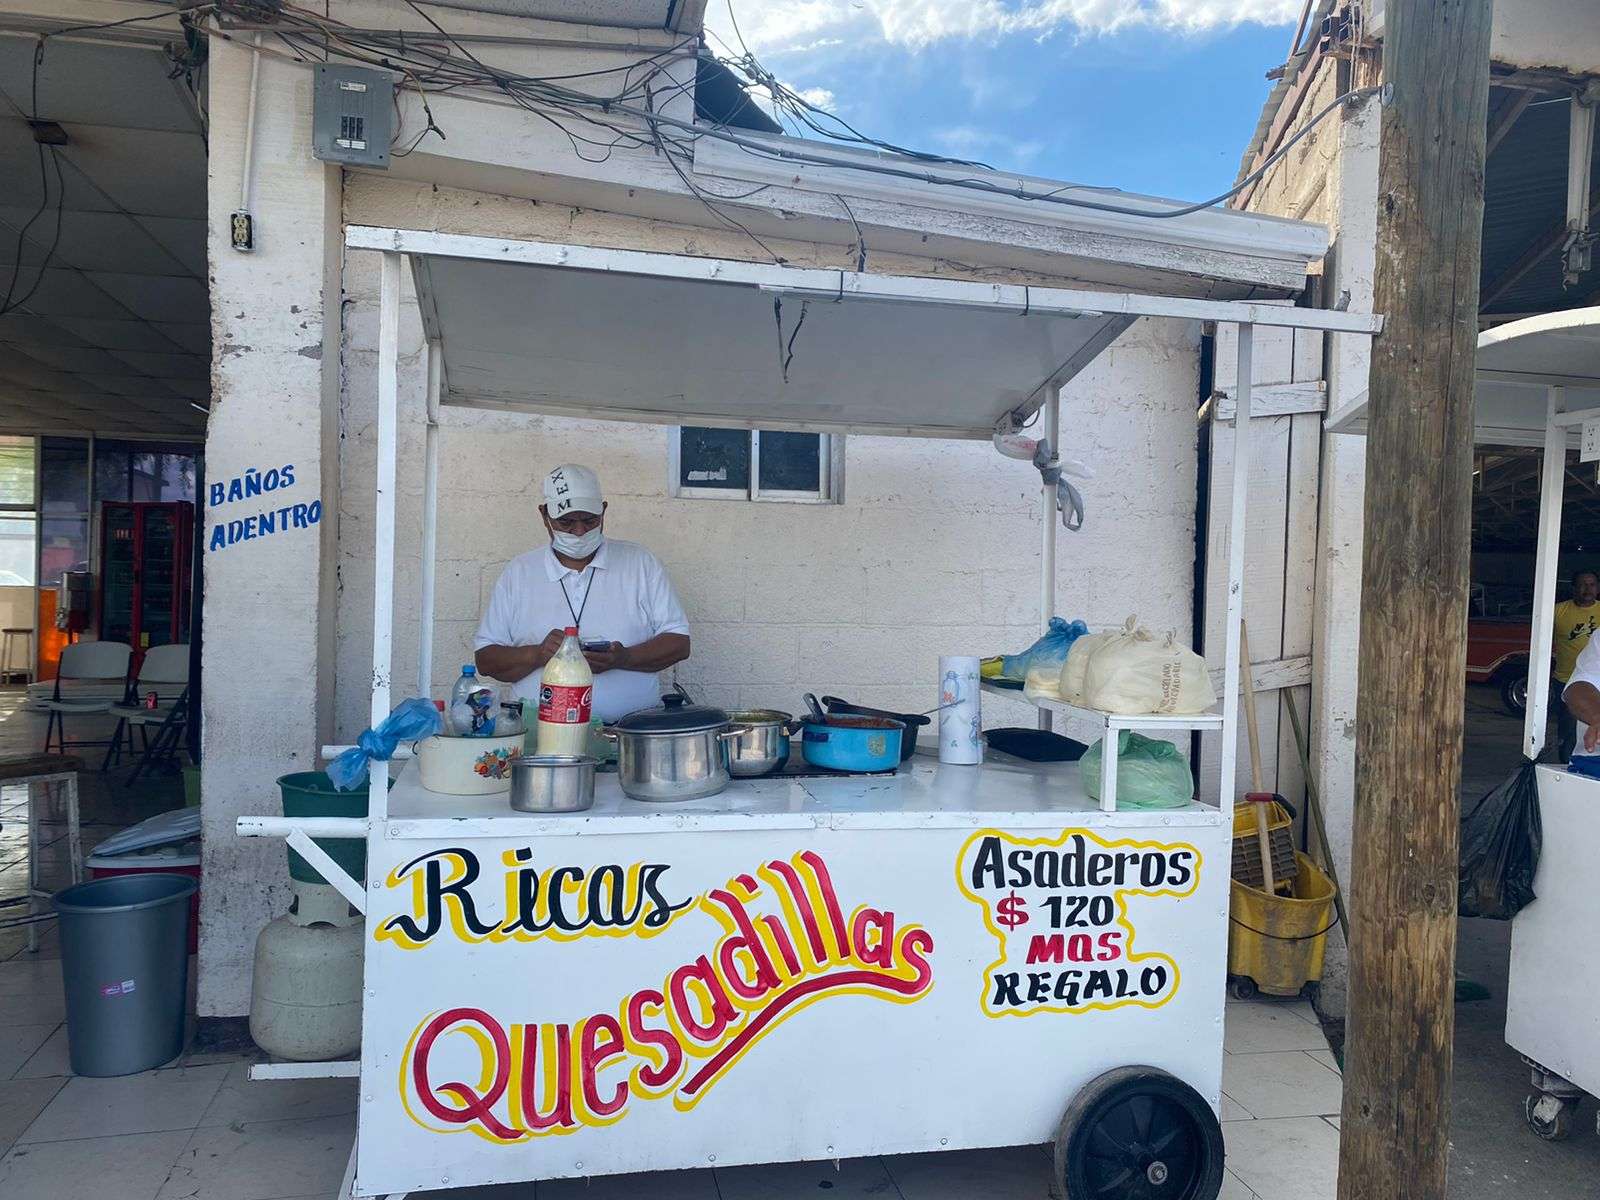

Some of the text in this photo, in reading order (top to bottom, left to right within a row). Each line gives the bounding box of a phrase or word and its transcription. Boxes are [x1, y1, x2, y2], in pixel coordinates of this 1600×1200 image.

[209, 464, 295, 507] BAÑOS
[209, 500, 322, 552] ADENTRO
[972, 834, 1192, 890] Asaderos
[381, 846, 694, 943] Ricas
[996, 890, 1114, 931] $ 120
[407, 849, 935, 1141] Quesadillas
[992, 965, 1167, 1007] REGALO
